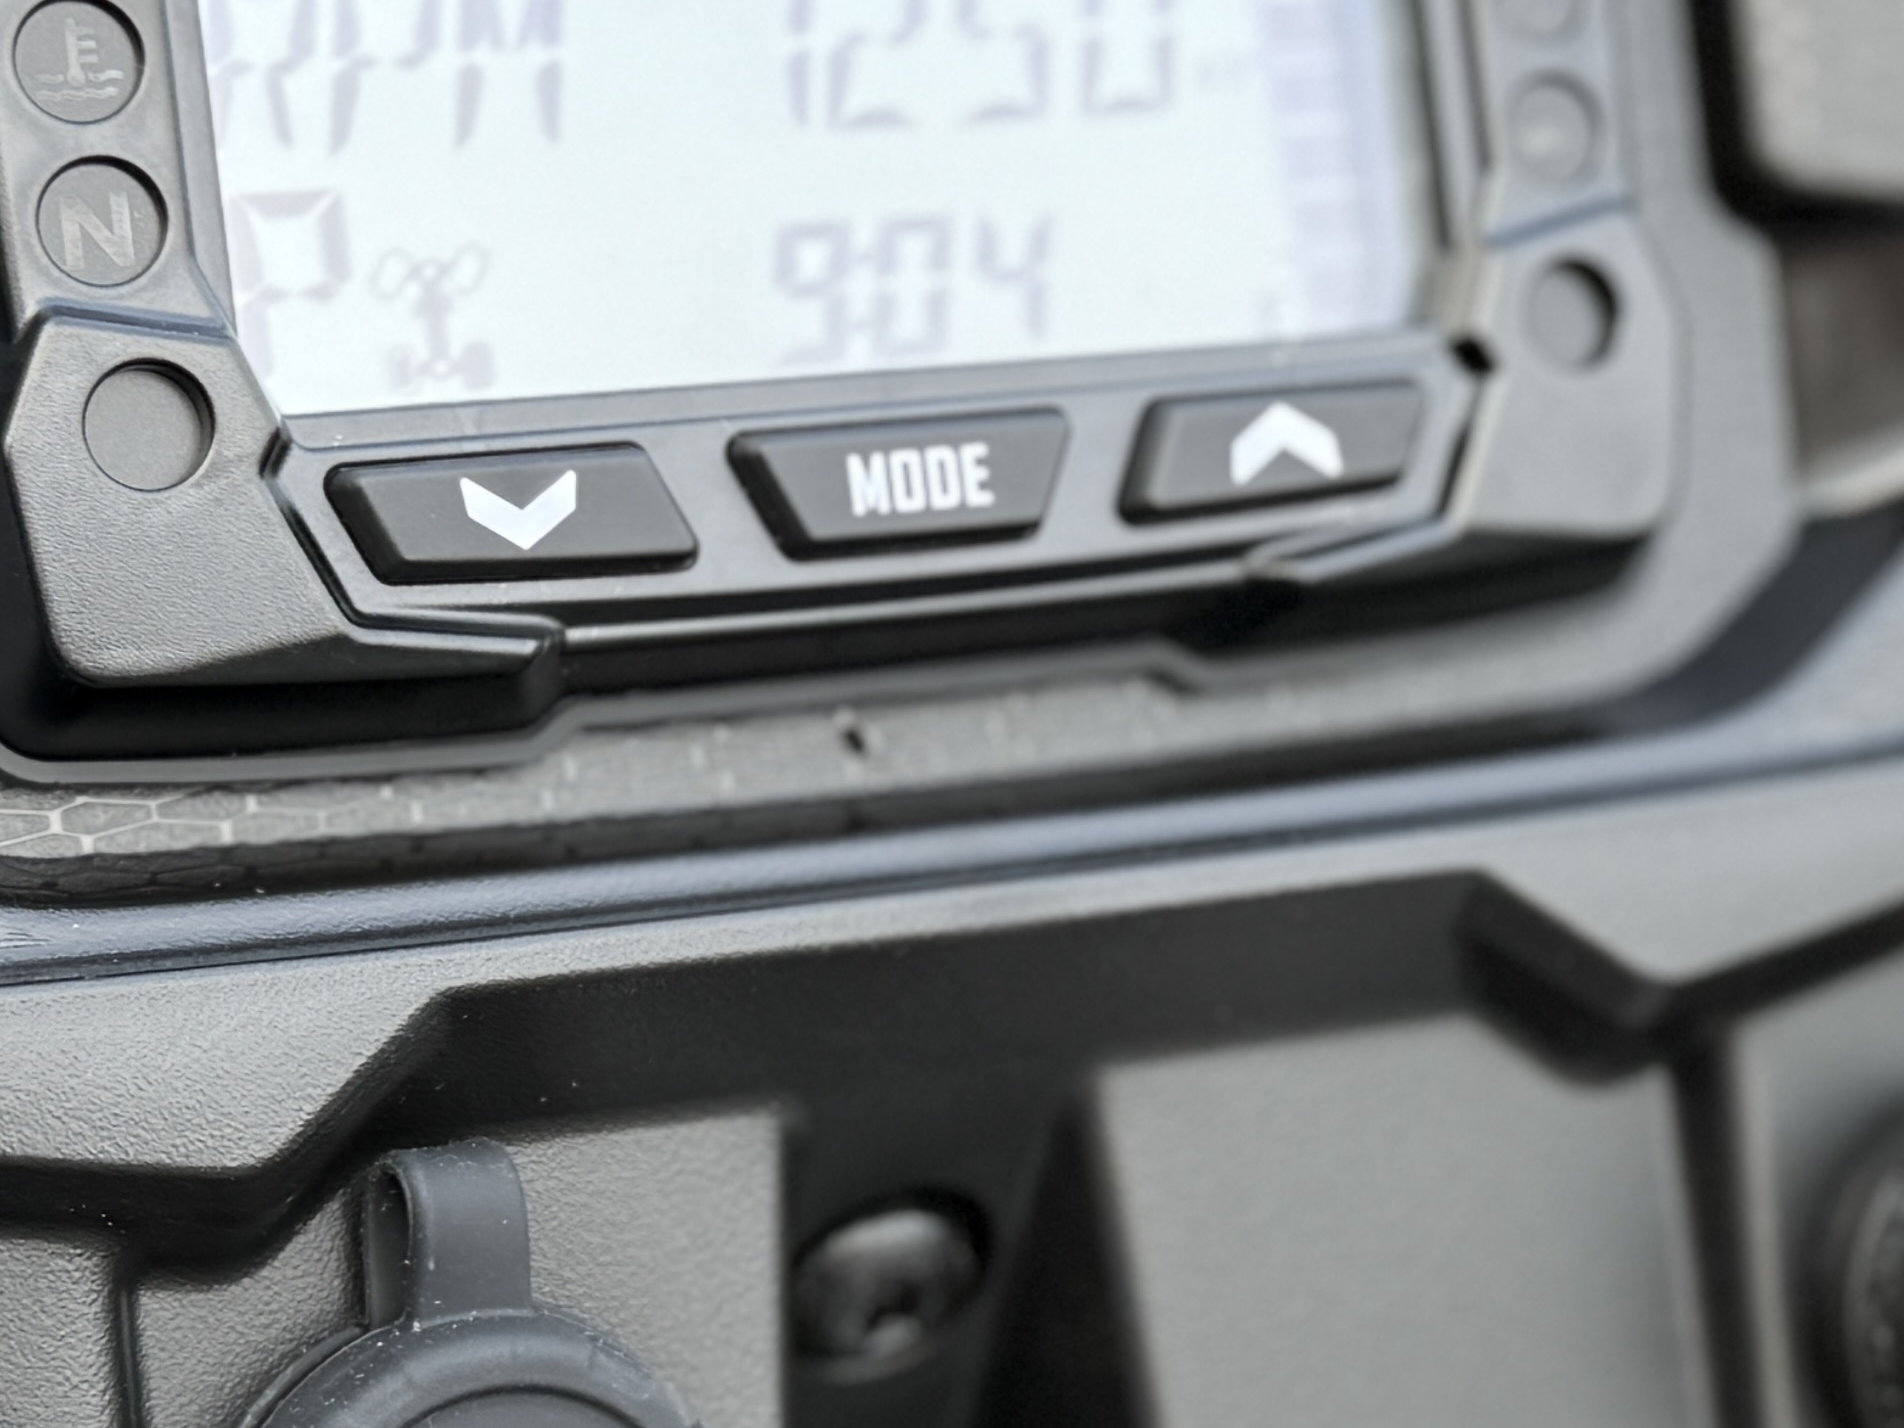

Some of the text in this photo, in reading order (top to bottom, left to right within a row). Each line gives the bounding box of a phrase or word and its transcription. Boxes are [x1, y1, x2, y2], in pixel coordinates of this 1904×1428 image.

[59, 191, 136, 271] N
[231, 188, 354, 384] P
[846, 441, 996, 517] MODE
